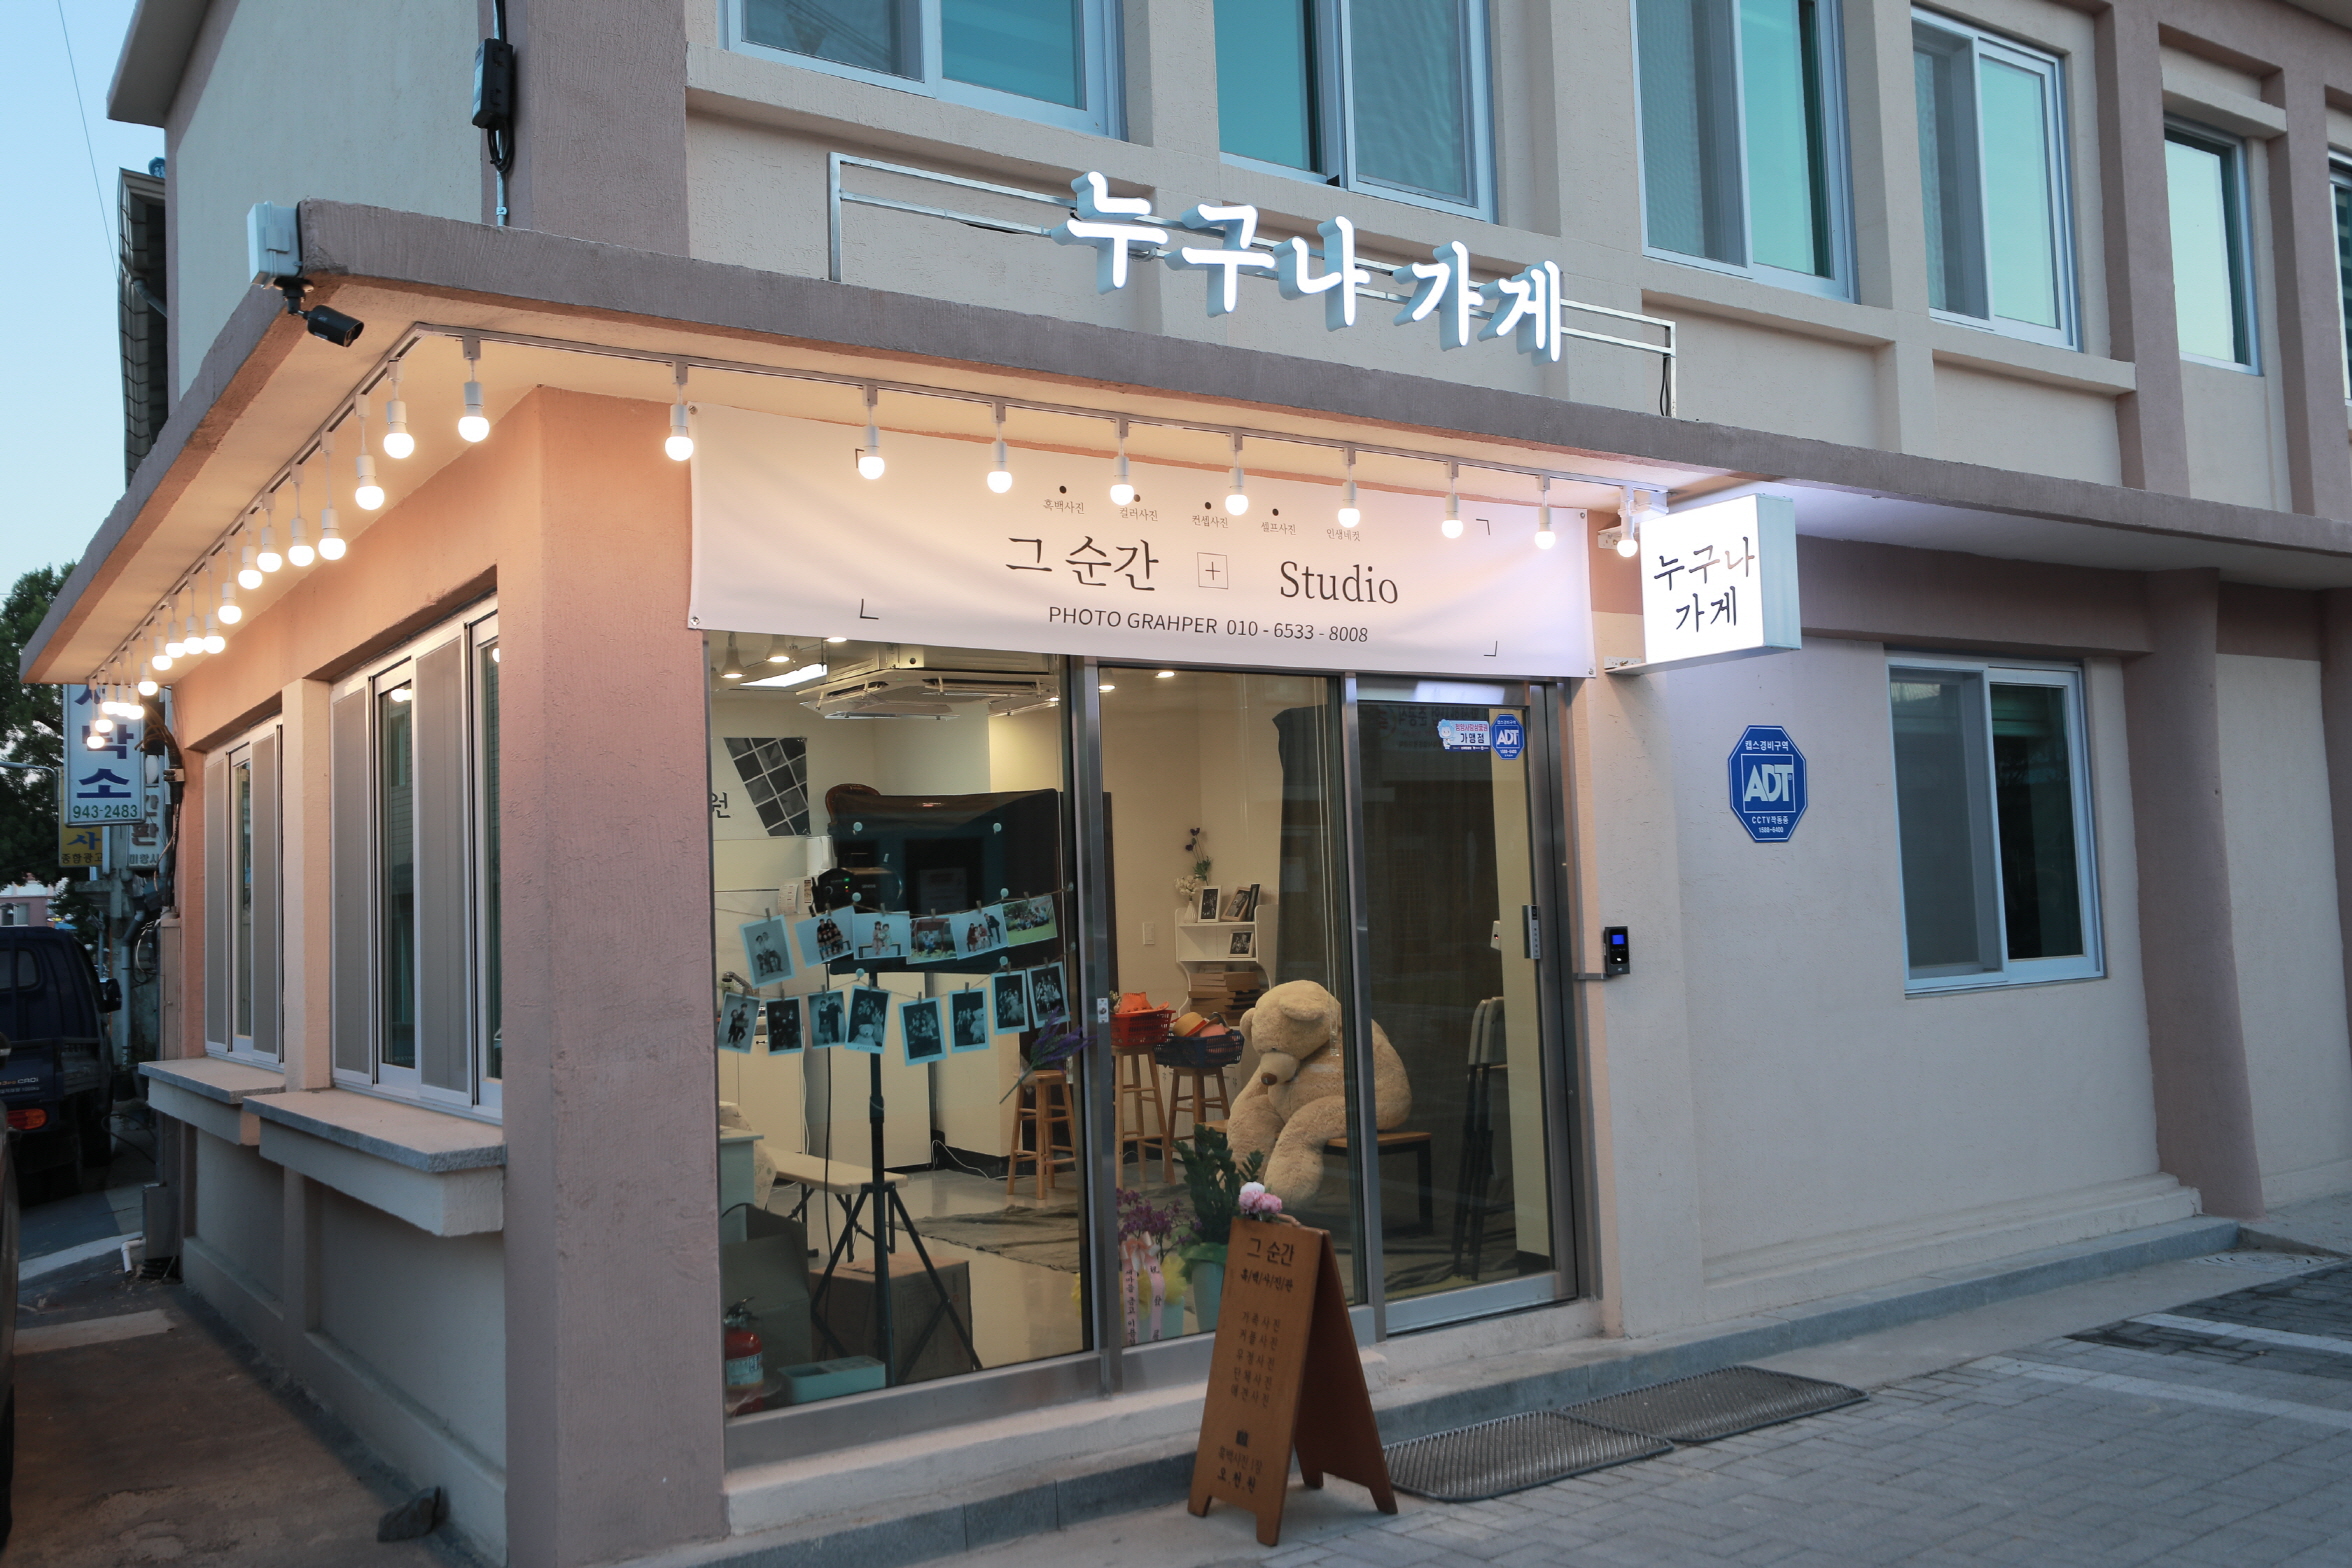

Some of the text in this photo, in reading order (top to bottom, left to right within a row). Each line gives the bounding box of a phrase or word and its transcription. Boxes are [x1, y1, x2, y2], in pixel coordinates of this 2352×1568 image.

[1056, 170, 1562, 364] 누구나 가게
[1043, 498, 1085, 515] 흑백사진
[1119, 507, 1159, 522] 컬러사진
[1191, 514, 1229, 529] 컨셉사진
[1261, 521, 1297, 536] 셀프사진
[1326, 527, 1361, 542] 인생네컷
[1006, 535, 1160, 592] 그 순간
[1653, 536, 1755, 591] 누구나
[1279, 560, 1399, 605] Studio
[1675, 585, 1737, 633] 가게
[1048, 606, 1122, 628] PHOTO
[1126, 611, 1218, 635] GRAHPER
[74, 684, 135, 798] 탁소
[1460, 732, 1485, 744] 가맹점
[1496, 729, 1519, 745] ADT
[1744, 740, 1789, 751] 캡스경비구역
[1743, 763, 1793, 802] ADT
[73, 804, 138, 819] 943-2483
[1751, 815, 1789, 825] CCTV작동중
